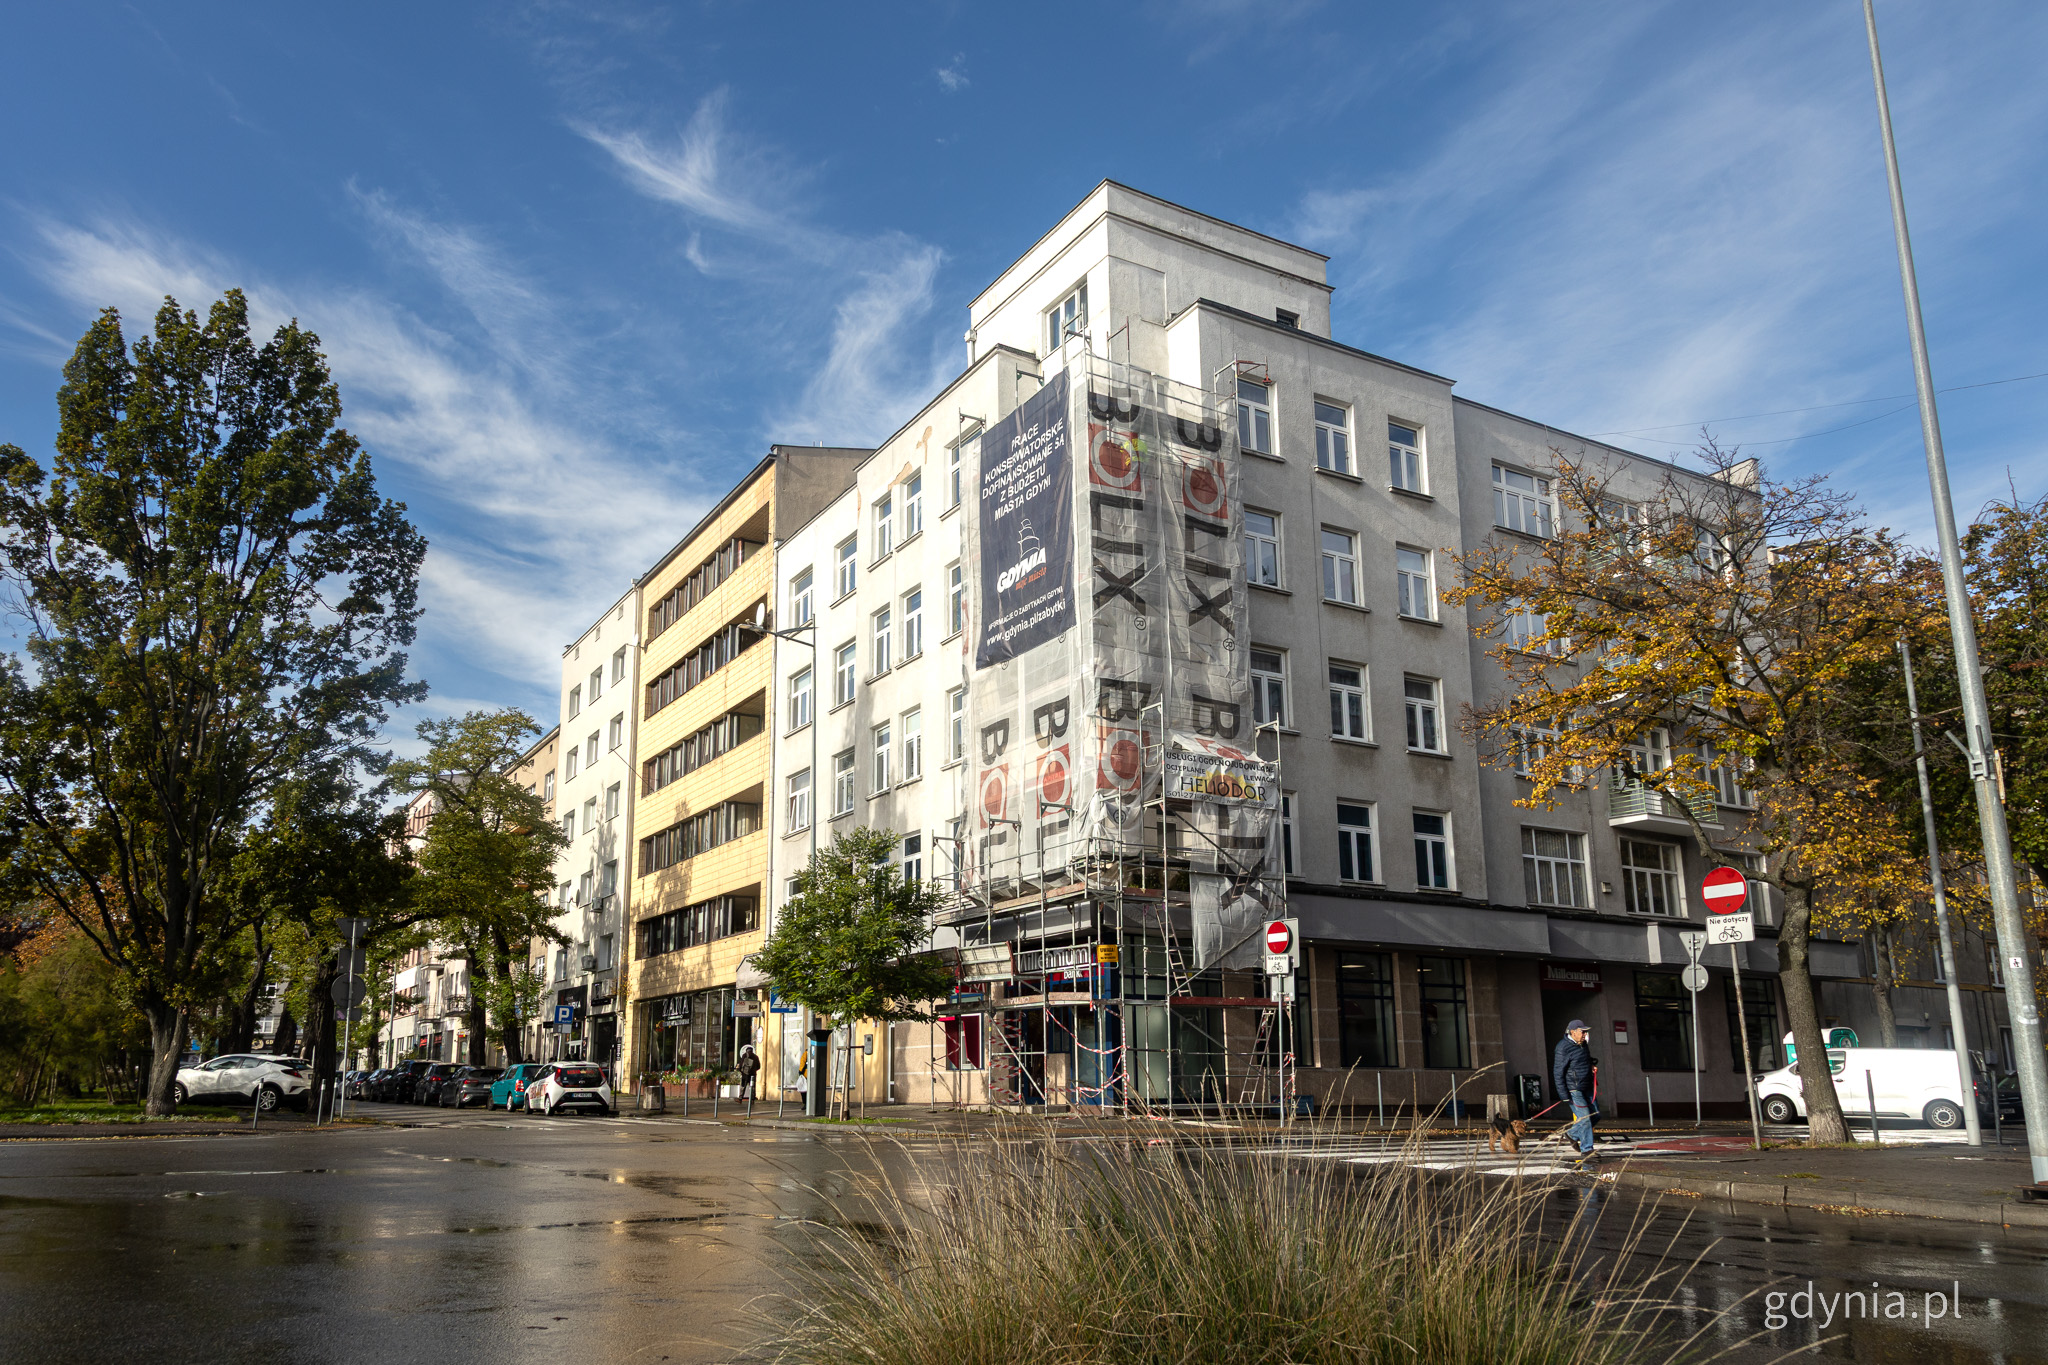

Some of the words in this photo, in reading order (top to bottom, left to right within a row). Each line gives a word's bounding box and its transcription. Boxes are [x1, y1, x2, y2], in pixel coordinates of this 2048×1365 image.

[982, 442, 1053, 499] DOFINANSOWANE
[984, 417, 1064, 484] KONSERWATORSKE
[995, 494, 1024, 521] MIASTA
[1026, 474, 1051, 500] GDYNI
[1000, 489, 1006, 502] Z
[1008, 463, 1046, 497] BUDŻETU
[997, 547, 1046, 593] GDYNIA
[986, 598, 1066, 646] www.gdynia.pl/zabytki
[1166, 752, 1197, 762] USŁUGI
[1181, 776, 1267, 801] HELIODOR
[1723, 916, 1749, 924] dotyczy
[1547, 965, 1599, 981] Millennium
